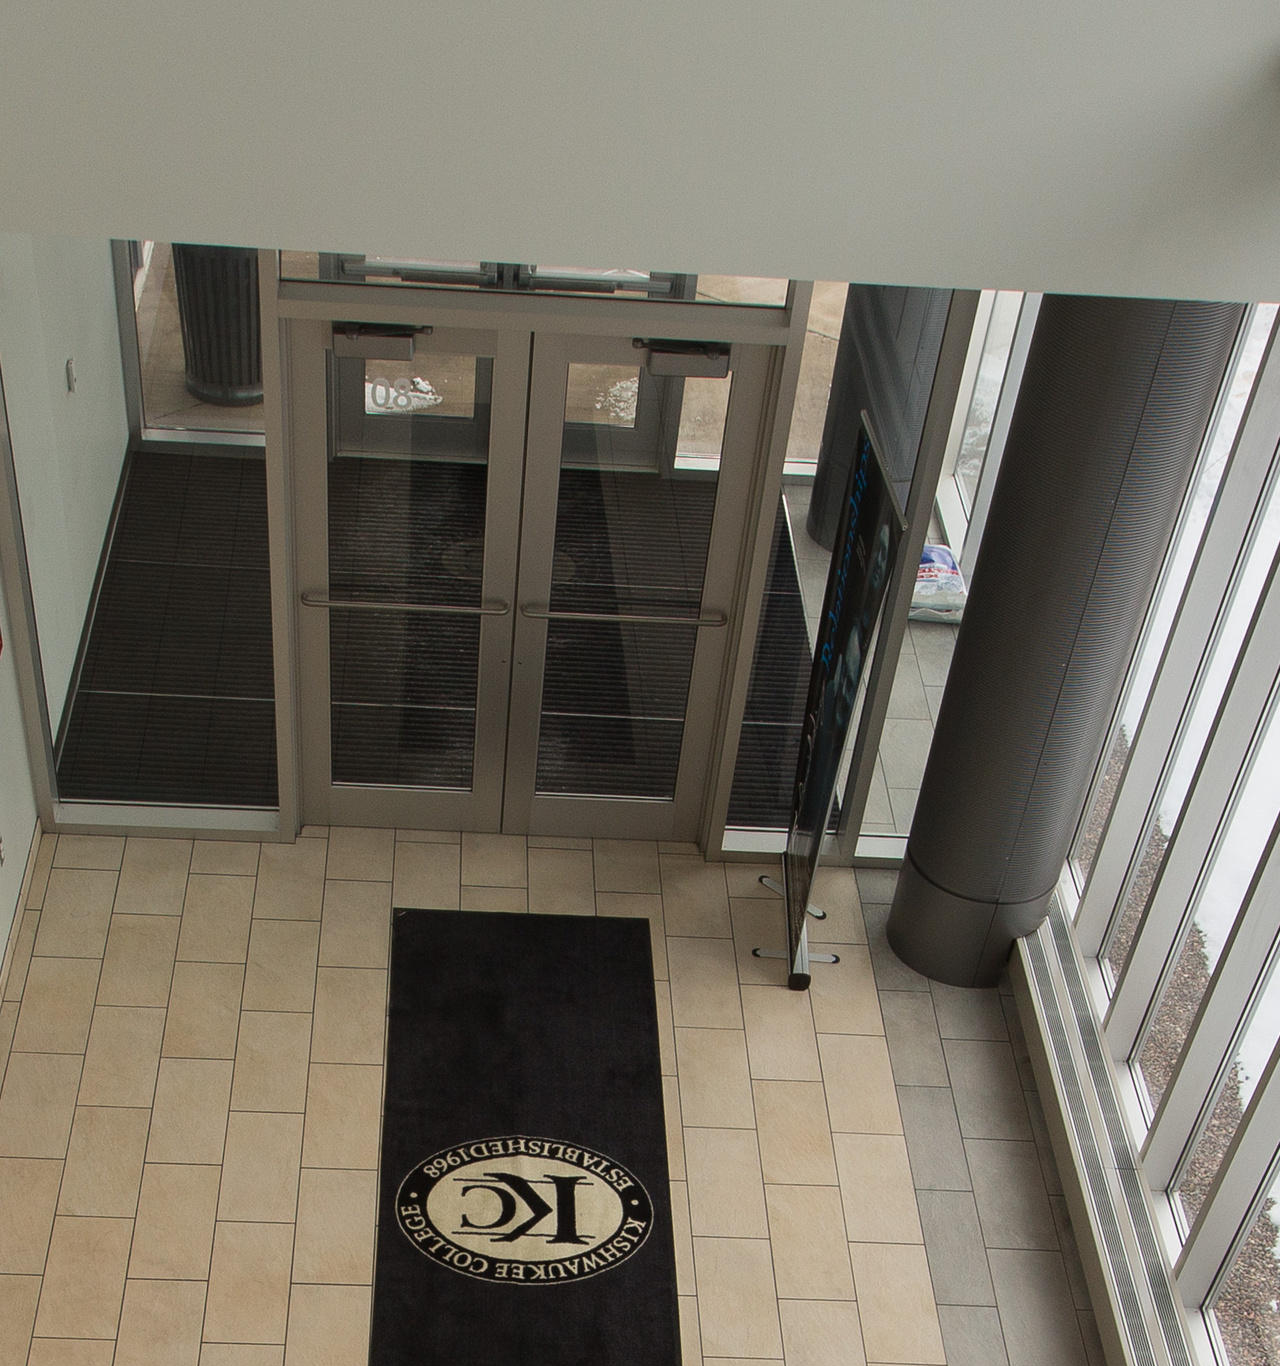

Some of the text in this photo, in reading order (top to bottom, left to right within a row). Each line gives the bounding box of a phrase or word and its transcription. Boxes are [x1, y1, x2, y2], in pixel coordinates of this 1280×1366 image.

[401, 1204, 647, 1281] KISHWAUKEE COLLEGE
[460, 1172, 588, 1245] KC
